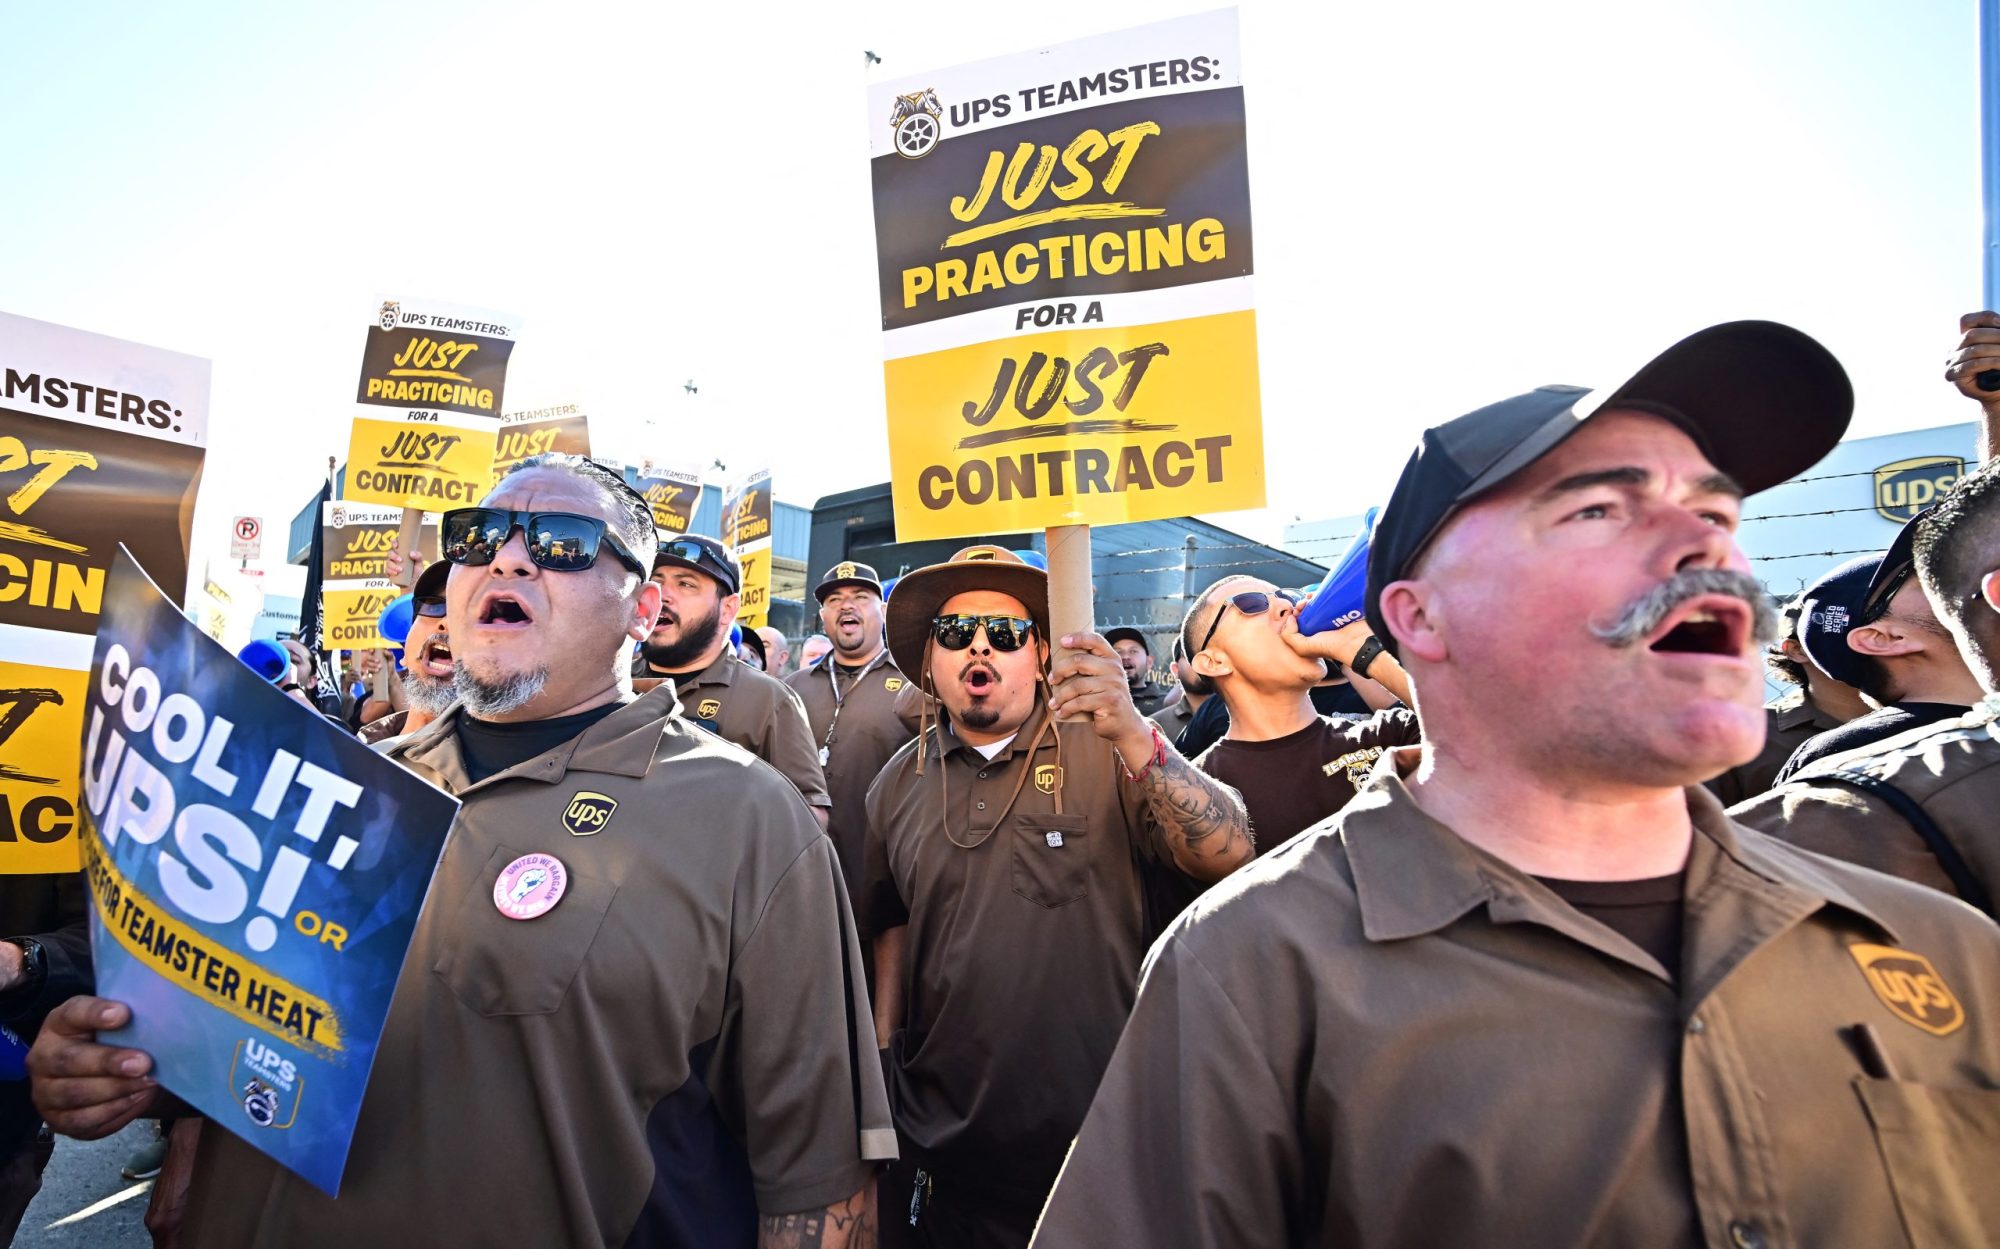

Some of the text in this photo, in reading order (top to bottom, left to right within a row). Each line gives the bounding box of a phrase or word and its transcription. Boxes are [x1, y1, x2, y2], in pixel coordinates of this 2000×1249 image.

[949, 55, 1221, 128] UPS TEAMSTERS:
[949, 120, 1161, 222] JUST
[902, 217, 1226, 309] PRACTICING
[401, 312, 511, 337] UPS TEAMSTERS:
[1015, 301, 1104, 331] FOR A
[393, 336, 479, 370] JUST
[0, 368, 182, 433] MSTERS:
[366, 378, 494, 410] PRACTICING
[961, 342, 1171, 427] JUST
[407, 410, 439, 423] FOR A
[380, 430, 462, 462] JUST
[495, 426, 562, 460] JUST
[355, 469, 479, 503] CONTRACT
[917, 434, 1233, 511] CONTRACT
[642, 483, 684, 504] JUST
[348, 513, 369, 522] UPS
[347, 529, 399, 552] JUS
[364, 580, 380, 588] FOR
[1824, 605, 1837, 633] WORLD
[1832, 606, 1846, 634] SERIES
[699, 703, 717, 716] ups
[100, 643, 240, 798] COOL
[251, 747, 365, 872] IT,
[1037, 773, 1055, 789] up
[84, 704, 312, 952] UPS!
[567, 801, 608, 828] ups
[506, 856, 539, 875] UNITED
[540, 857, 553, 868] WE
[544, 864, 561, 902] BARGAIN
[294, 910, 349, 951] OR
[120, 896, 241, 1001] TEAMSTER
[246, 978, 324, 1041] HEAT
[1868, 966, 1952, 1019] ups
[246, 1037, 297, 1083] UPS
